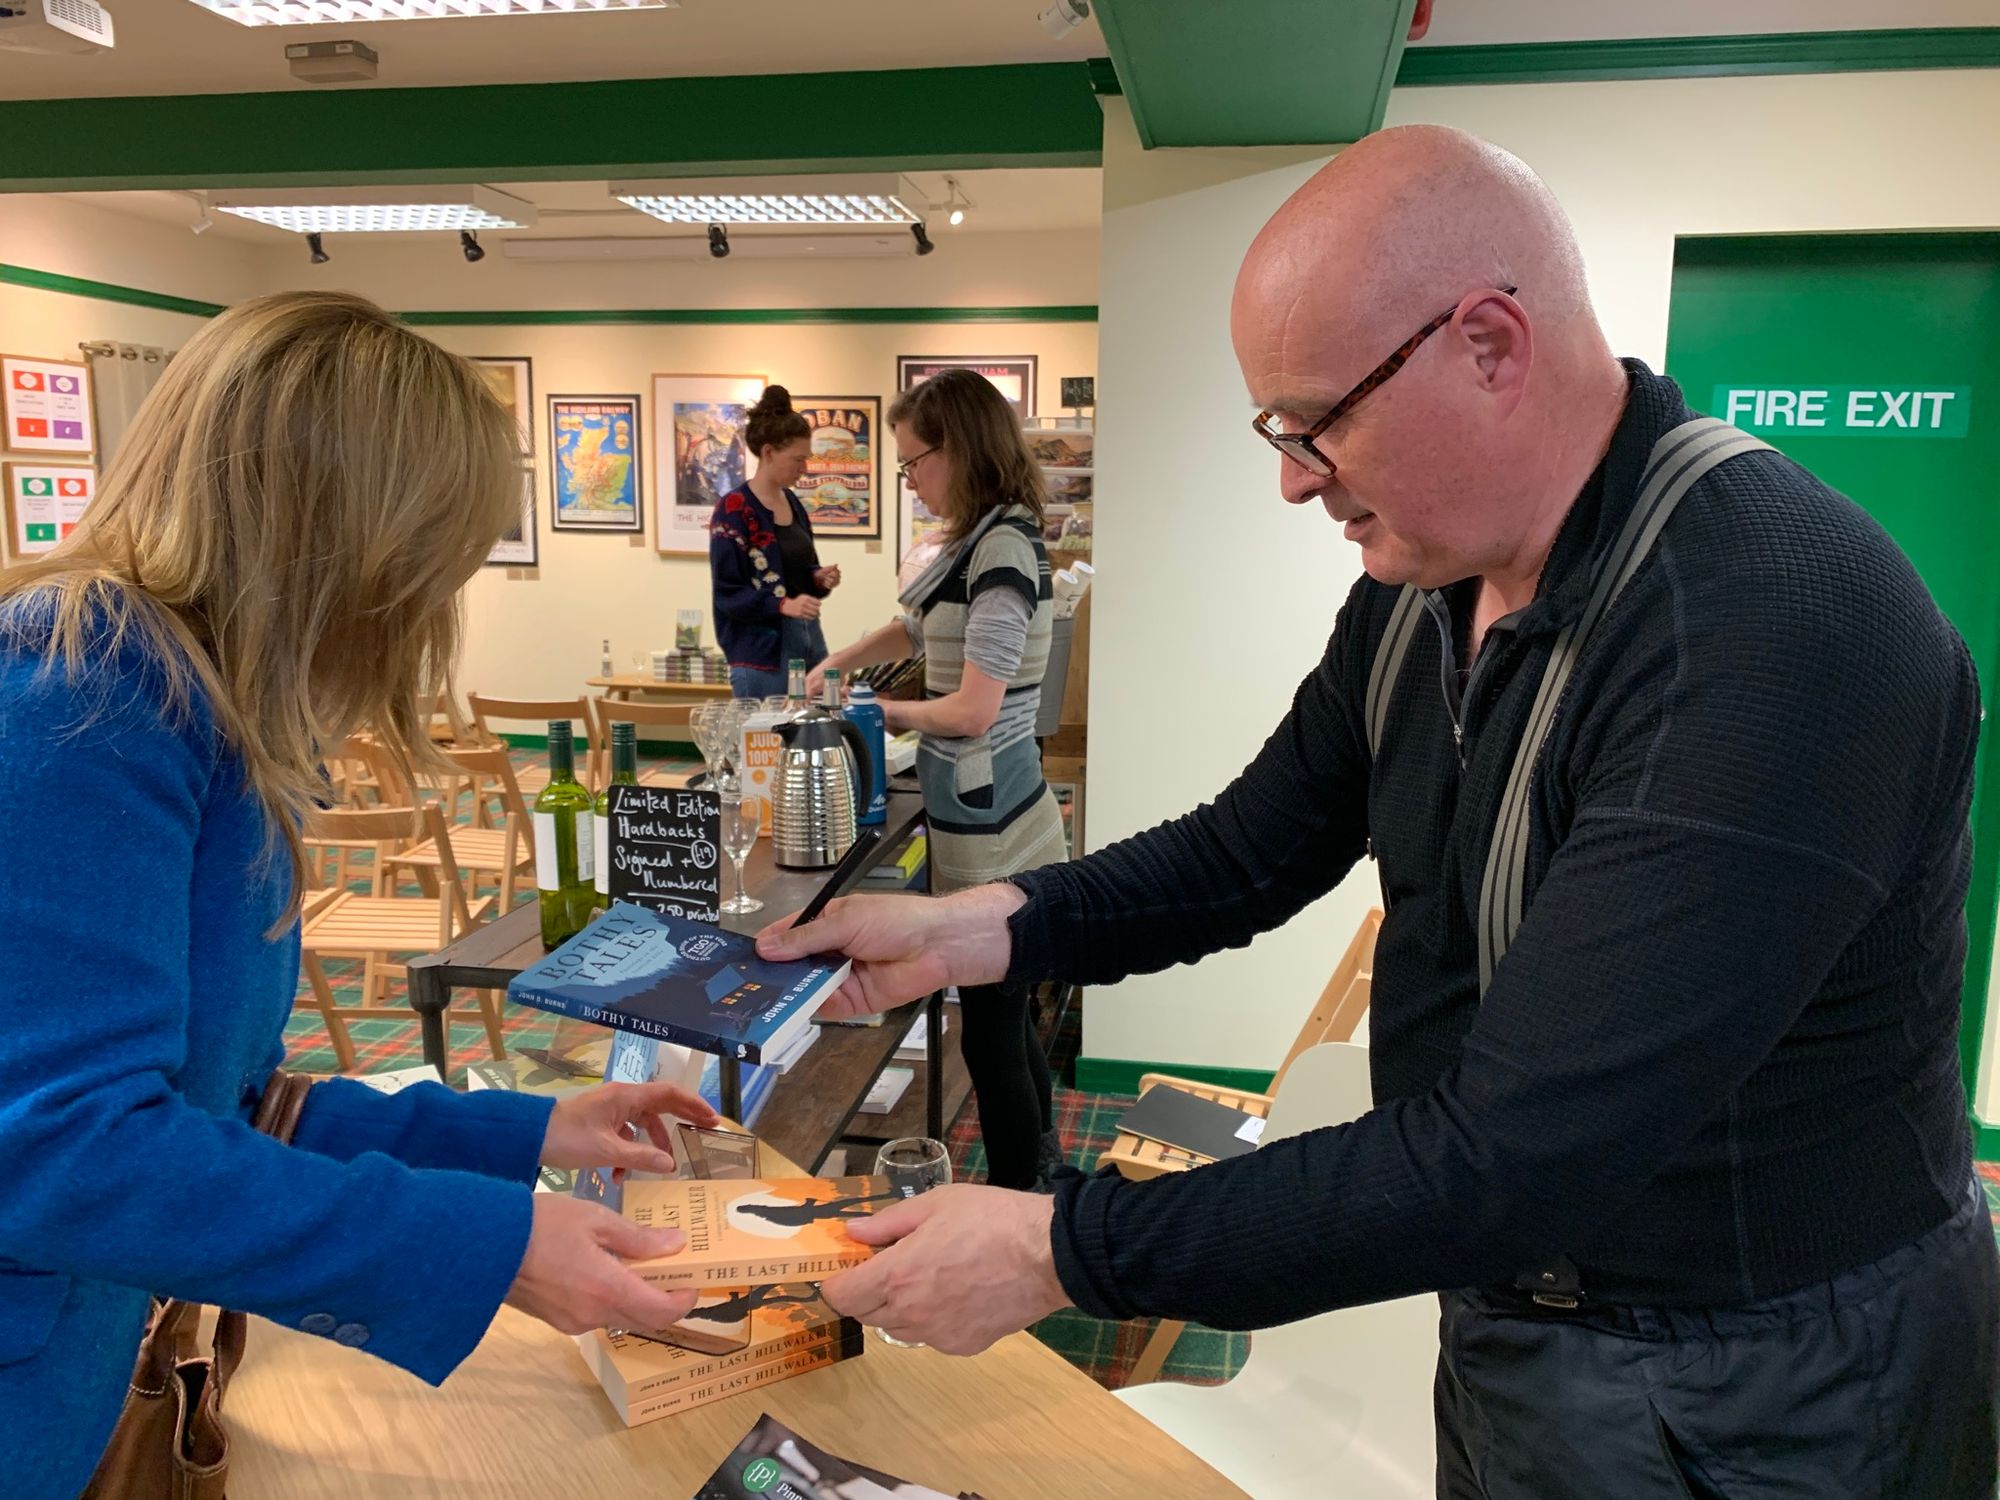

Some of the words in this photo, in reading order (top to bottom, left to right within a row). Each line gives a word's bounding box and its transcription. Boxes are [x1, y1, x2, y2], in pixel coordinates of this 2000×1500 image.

[1727, 390, 1828, 426] FIRE
[1846, 391, 1955, 428] EXIT
[750, 732, 781, 748] JUIC
[613, 787, 671, 814] Limited
[676, 793, 720, 822] Edition
[618, 815, 705, 839] Hardbacks
[615, 844, 673, 876] Signed
[643, 870, 718, 894] Numbered
[534, 912, 636, 981] BOTHY
[567, 924, 657, 981] TALES
[761, 1001, 788, 1023] JOHN
[783, 994, 798, 1002] D.
[792, 968, 823, 993] BURNS
[583, 1006, 628, 1026] BOTHY
[631, 1017, 670, 1037] TALES
[688, 1185, 709, 1252] HILLWALKER
[704, 1267, 739, 1280] THE
[747, 1263, 790, 1277] LAST
[688, 1363, 714, 1379] THE
[719, 1355, 751, 1370] LAST
[688, 1387, 714, 1402] THE
[720, 1376, 751, 1393] LAST
